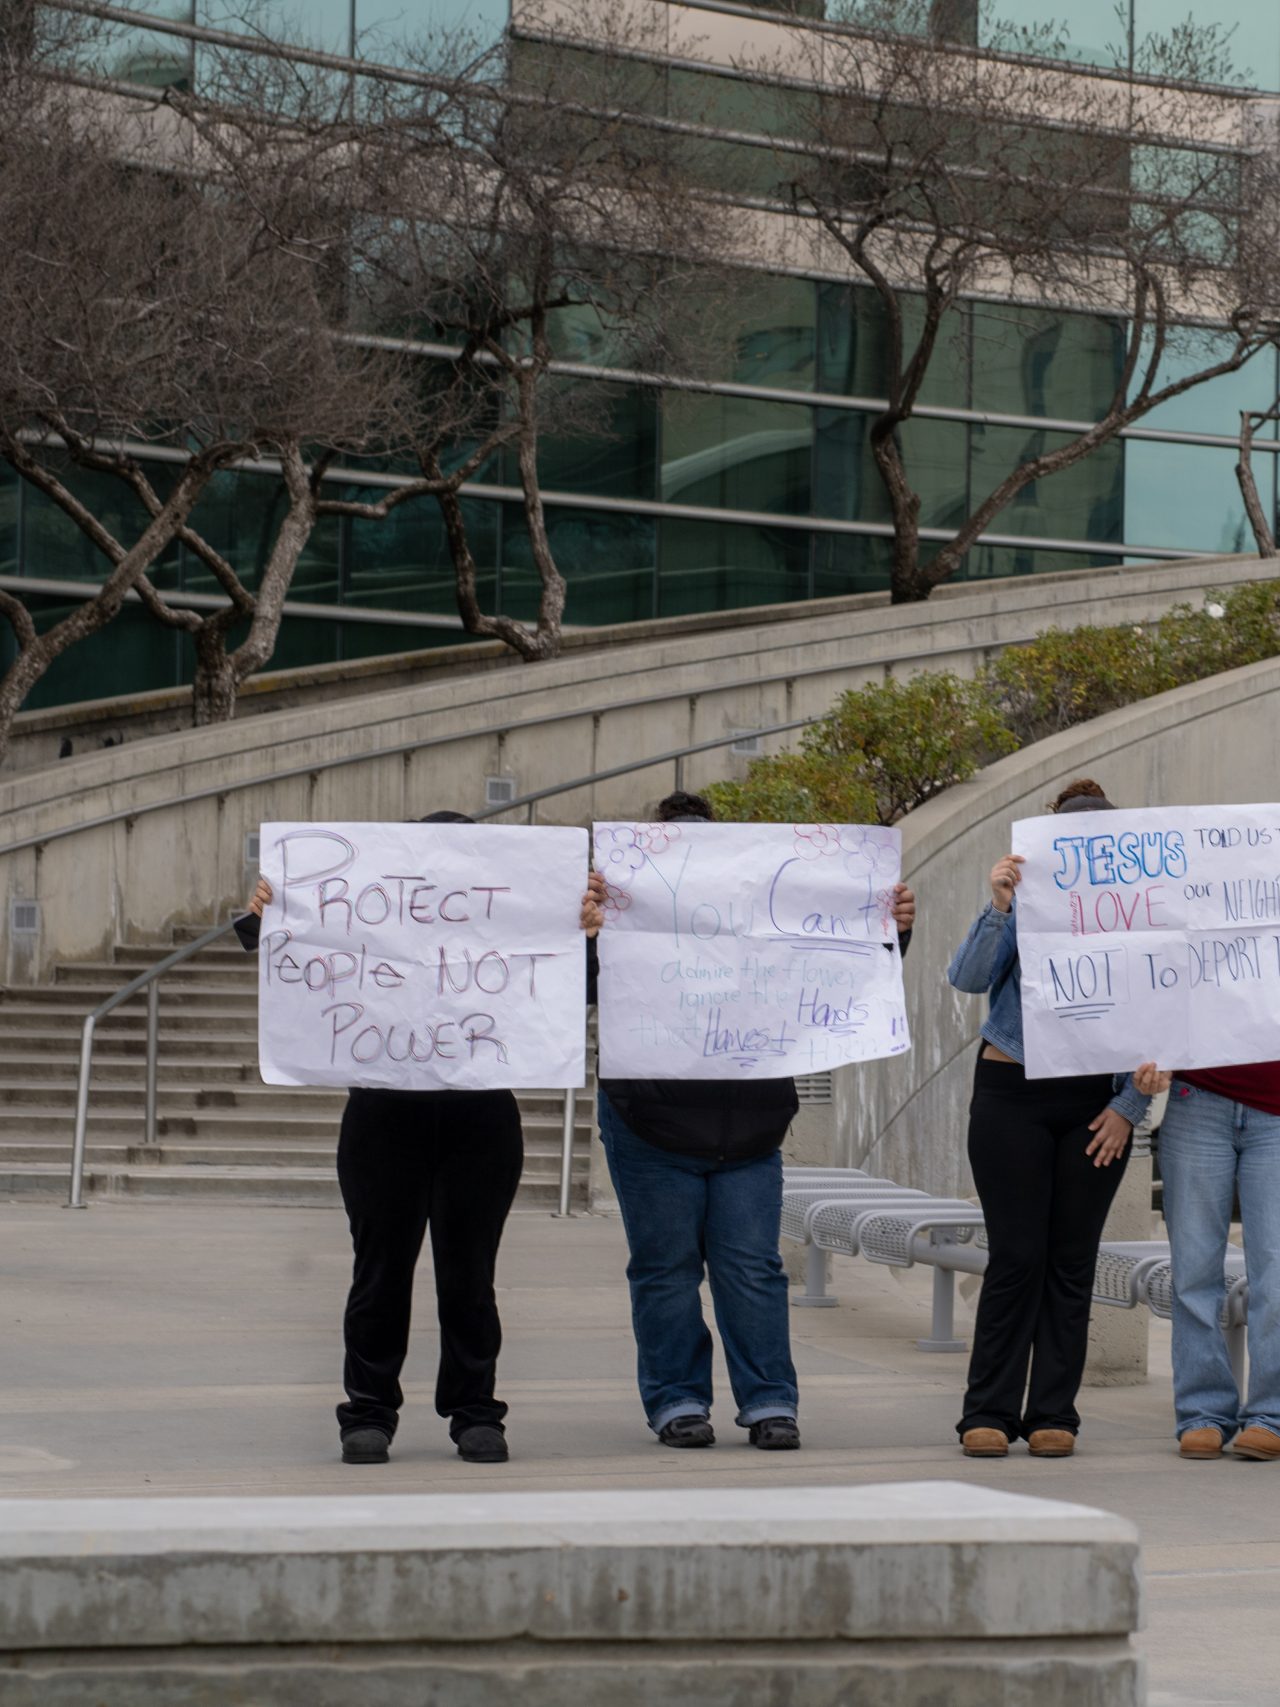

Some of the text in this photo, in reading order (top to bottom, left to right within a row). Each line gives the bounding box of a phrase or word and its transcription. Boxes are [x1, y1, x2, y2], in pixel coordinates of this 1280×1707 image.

[274, 829, 512, 936] PROTECT
[1052, 830, 1188, 891] JESUS
[1194, 828, 1242, 850] TOLD
[1247, 827, 1273, 847] US
[1070, 885, 1169, 937] LOVE
[437, 945, 560, 1001] NOT
[740, 956, 777, 981] the
[1048, 949, 1123, 1003] NOT
[1187, 935, 1264, 989] DEPORT
[321, 1002, 511, 1066] POWER
[796, 987, 870, 1025] Hands
